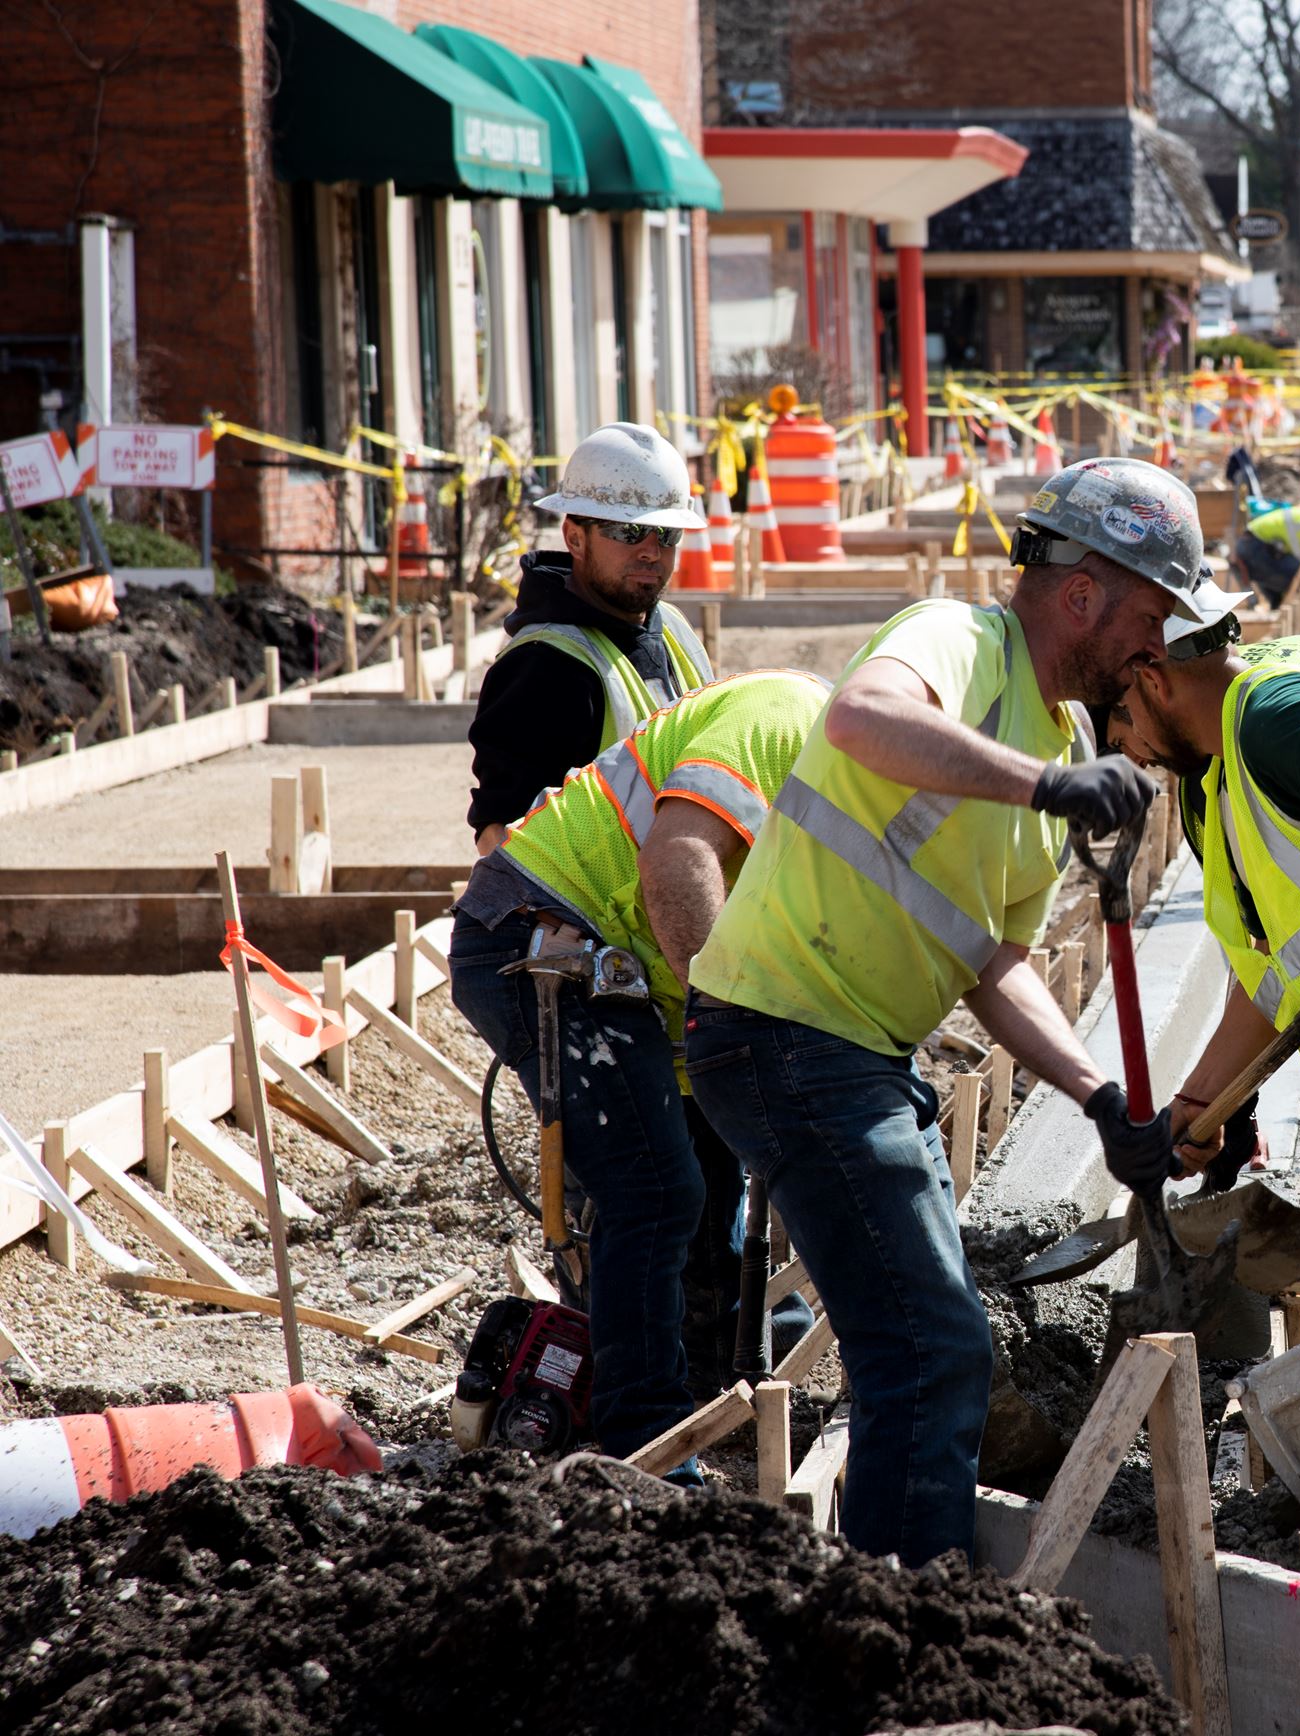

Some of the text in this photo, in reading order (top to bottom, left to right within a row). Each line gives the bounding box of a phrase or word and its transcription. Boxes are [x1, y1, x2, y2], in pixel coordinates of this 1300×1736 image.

[134, 434, 157, 446] NO
[113, 448, 178, 460] PARKING
[115, 462, 176, 472] TOW AWAY
[521, 1409, 550, 1424] HONDA
